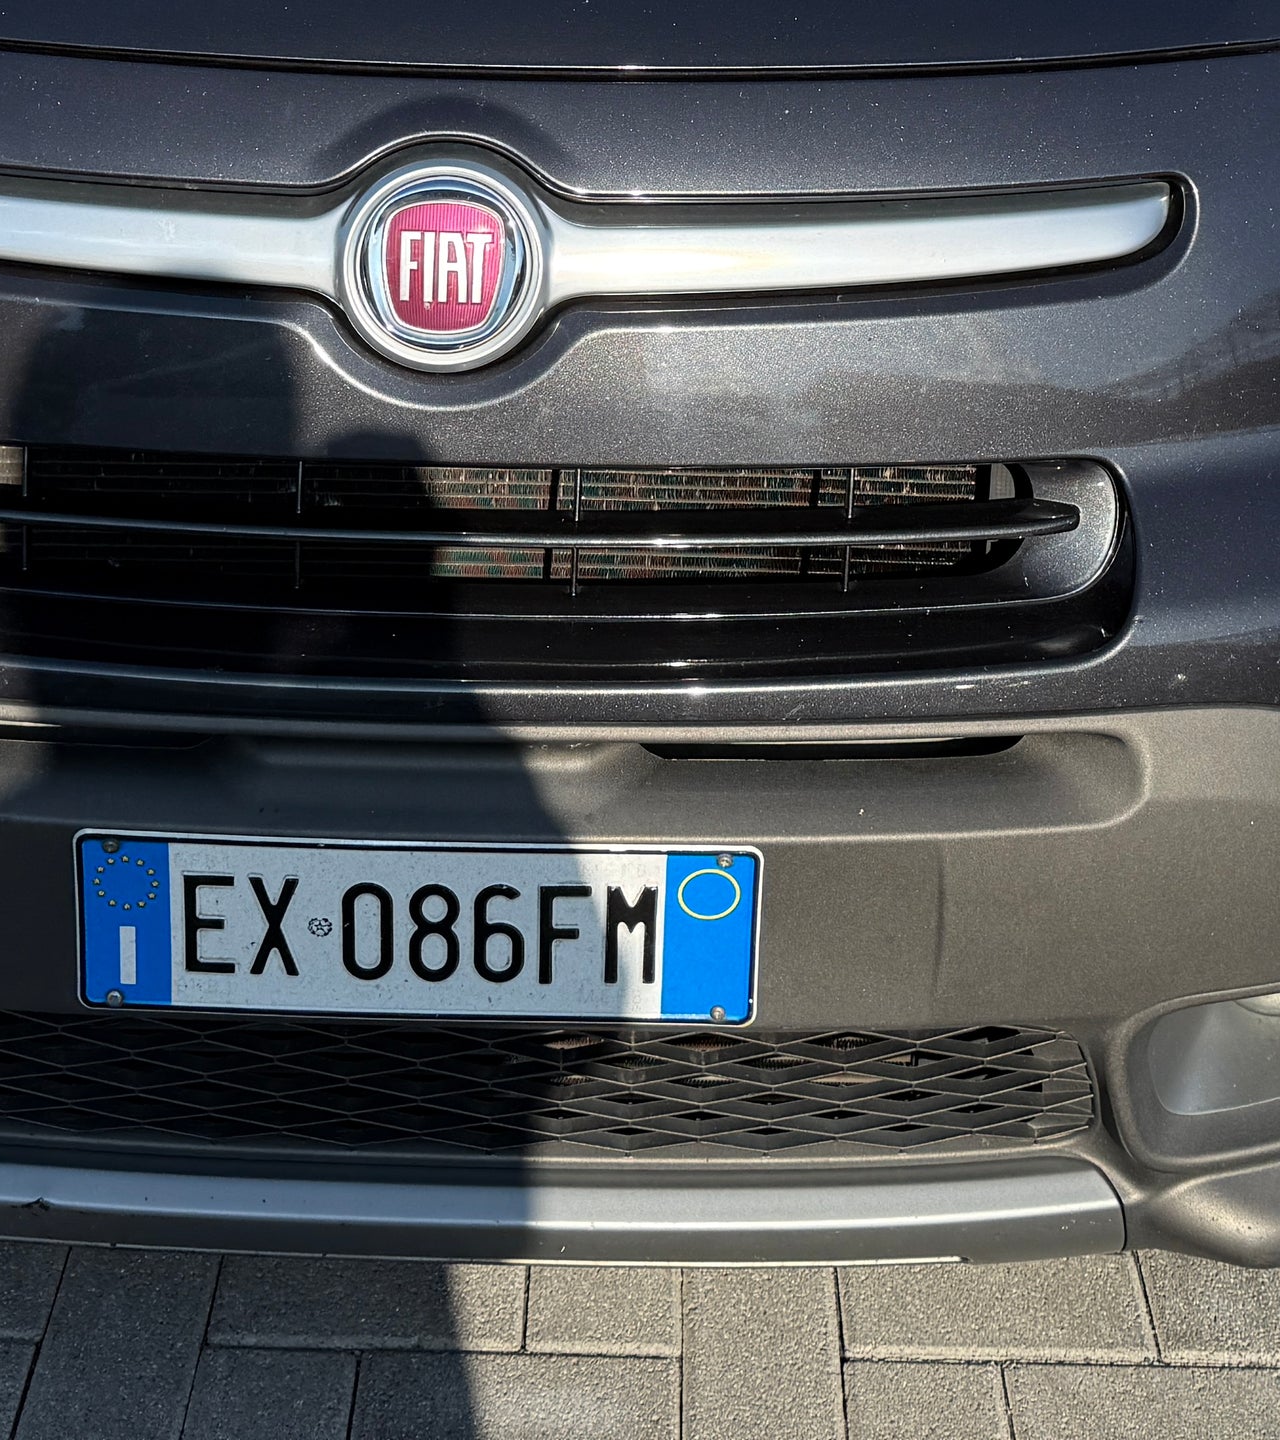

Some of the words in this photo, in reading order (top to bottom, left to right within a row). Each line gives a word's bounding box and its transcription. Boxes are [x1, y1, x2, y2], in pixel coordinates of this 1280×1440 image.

[399, 230, 495, 305] FIAT
[182, 873, 300, 977] EX
[340, 881, 658, 985] 086FM
